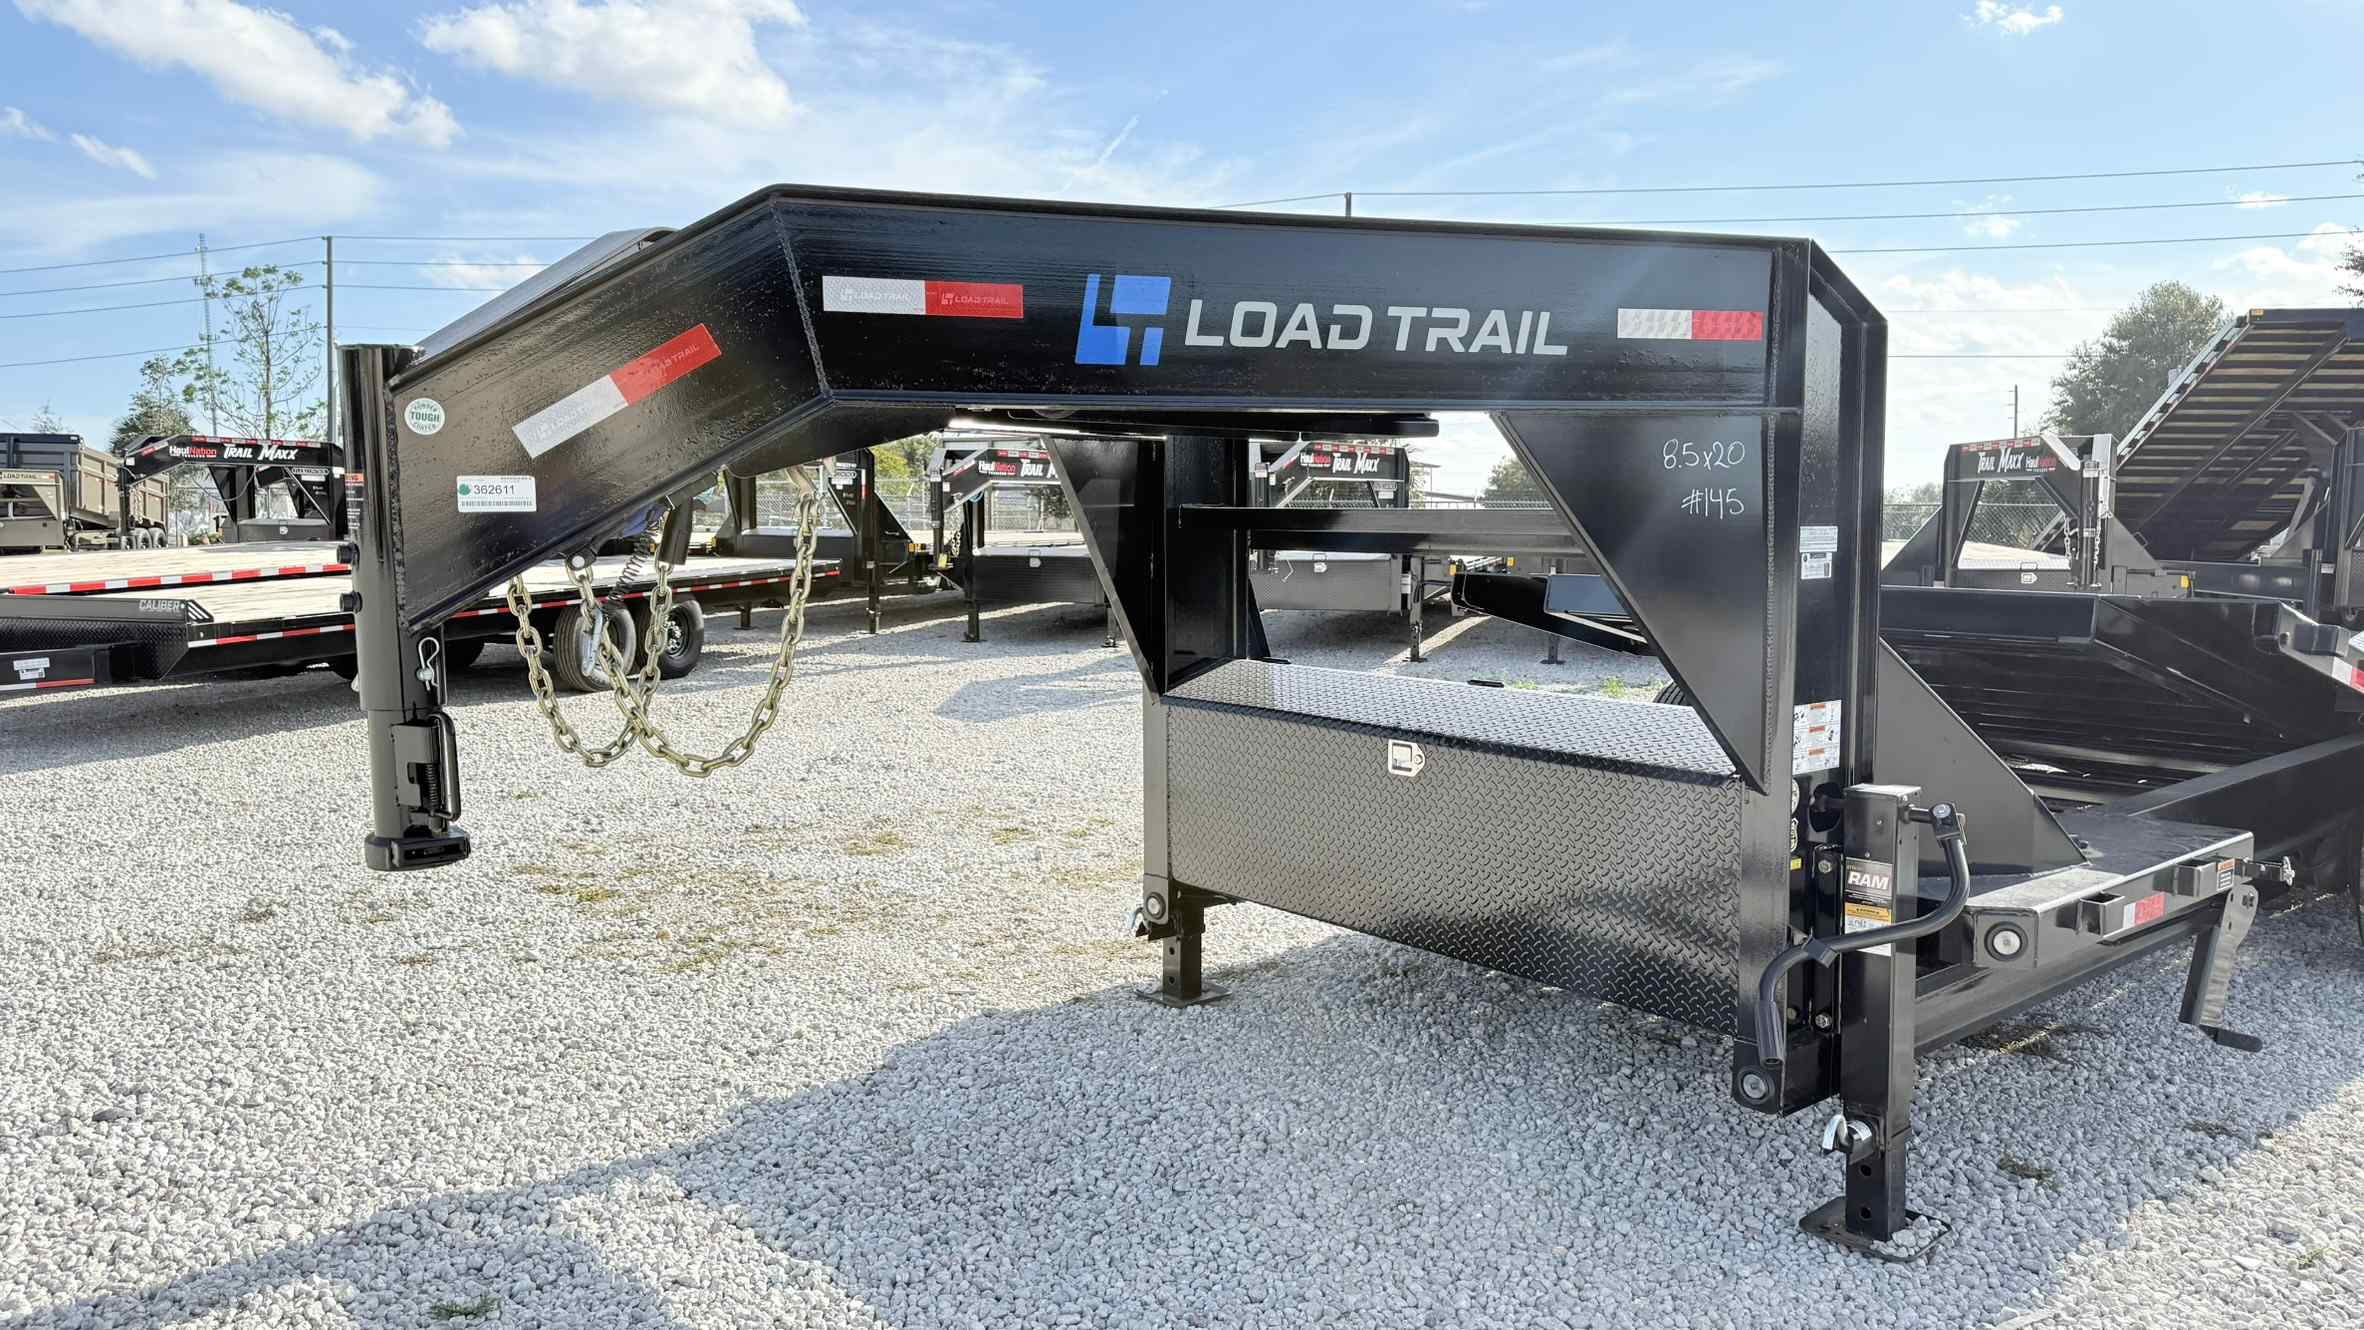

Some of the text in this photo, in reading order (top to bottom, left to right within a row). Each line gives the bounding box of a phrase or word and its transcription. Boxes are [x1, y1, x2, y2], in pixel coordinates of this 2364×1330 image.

[1185, 299, 1373, 351] LOAD
[1388, 306, 1569, 356] TRAIL
[410, 411, 440, 423] TOUGH
[1663, 438, 1745, 471] 8.5x20
[473, 484, 515, 496] 362611
[1681, 487, 1745, 520] #145
[138, 599, 181, 611] CALIBER
[1847, 871, 1890, 890] RAM
